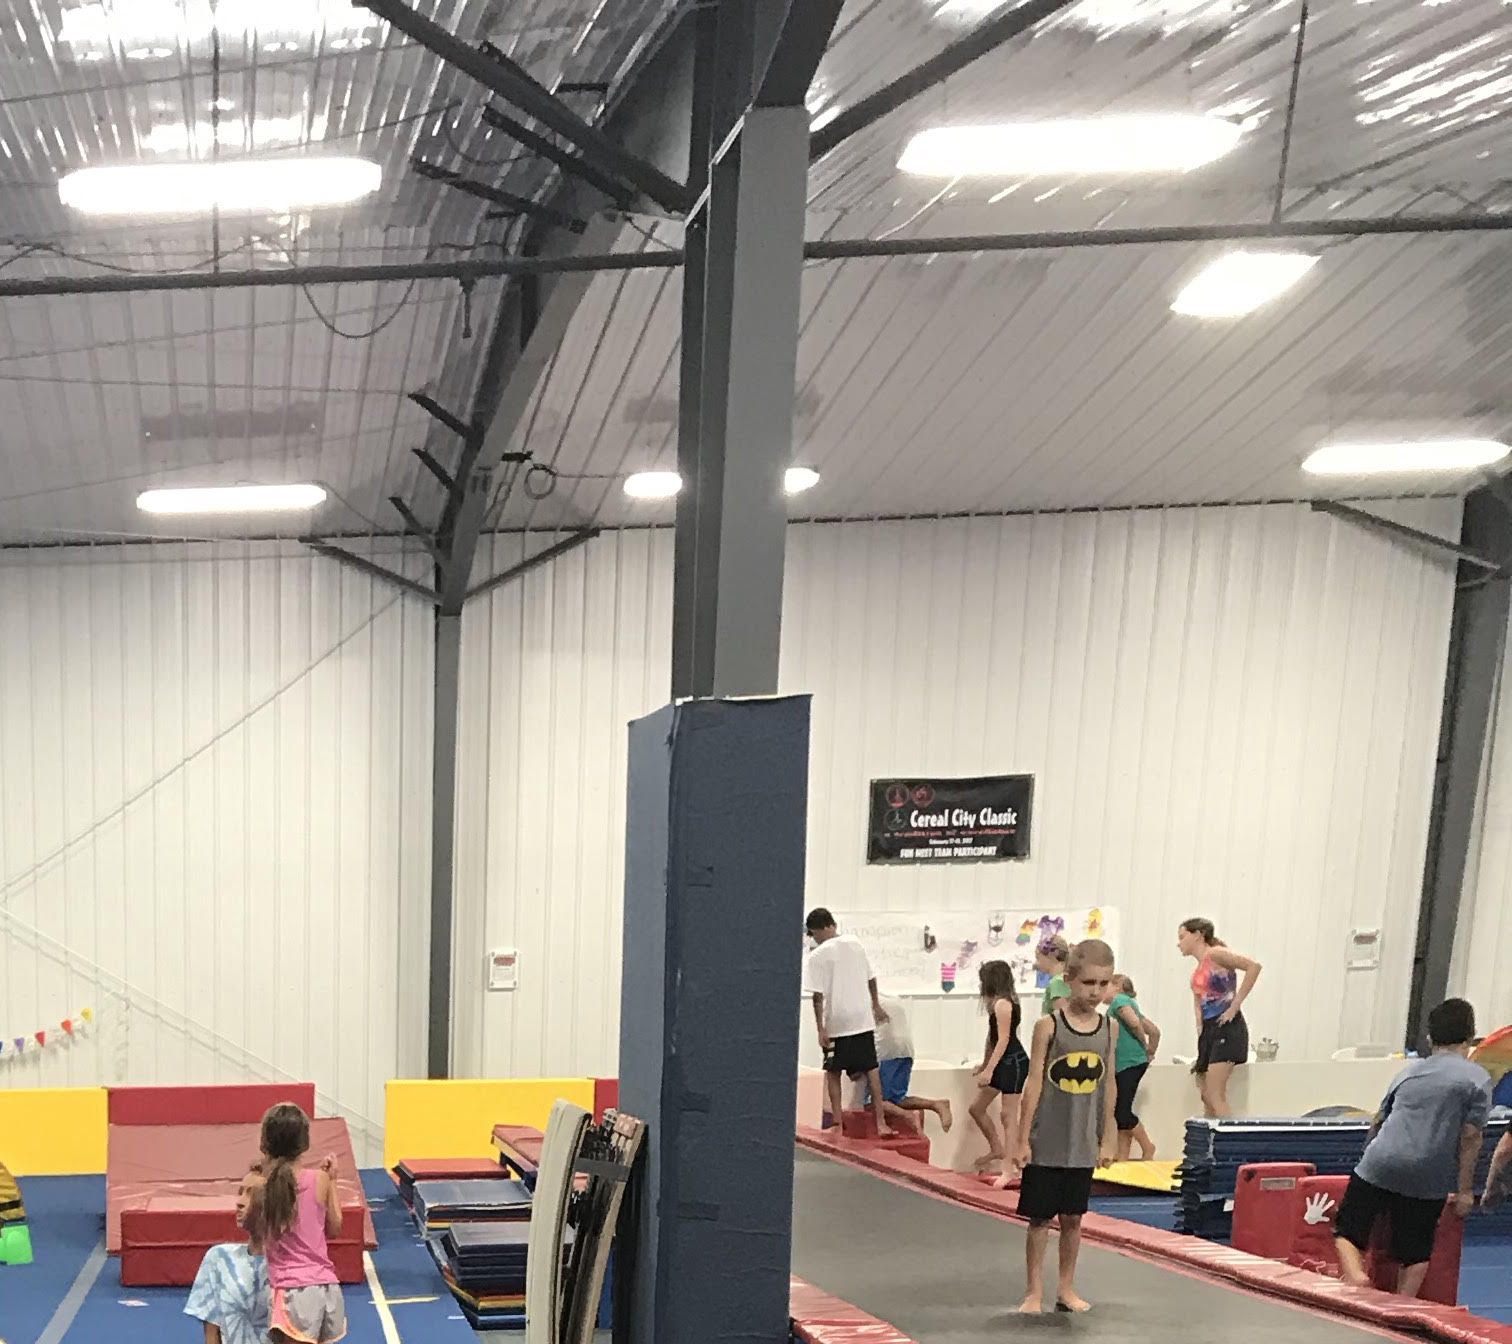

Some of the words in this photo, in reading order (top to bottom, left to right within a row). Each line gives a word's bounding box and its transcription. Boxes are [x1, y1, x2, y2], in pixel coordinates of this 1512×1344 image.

[910, 809, 949, 828] Cereal
[952, 808, 977, 828] City
[979, 807, 1018, 826] Classic
[953, 846, 998, 857] PARTICIPANT
